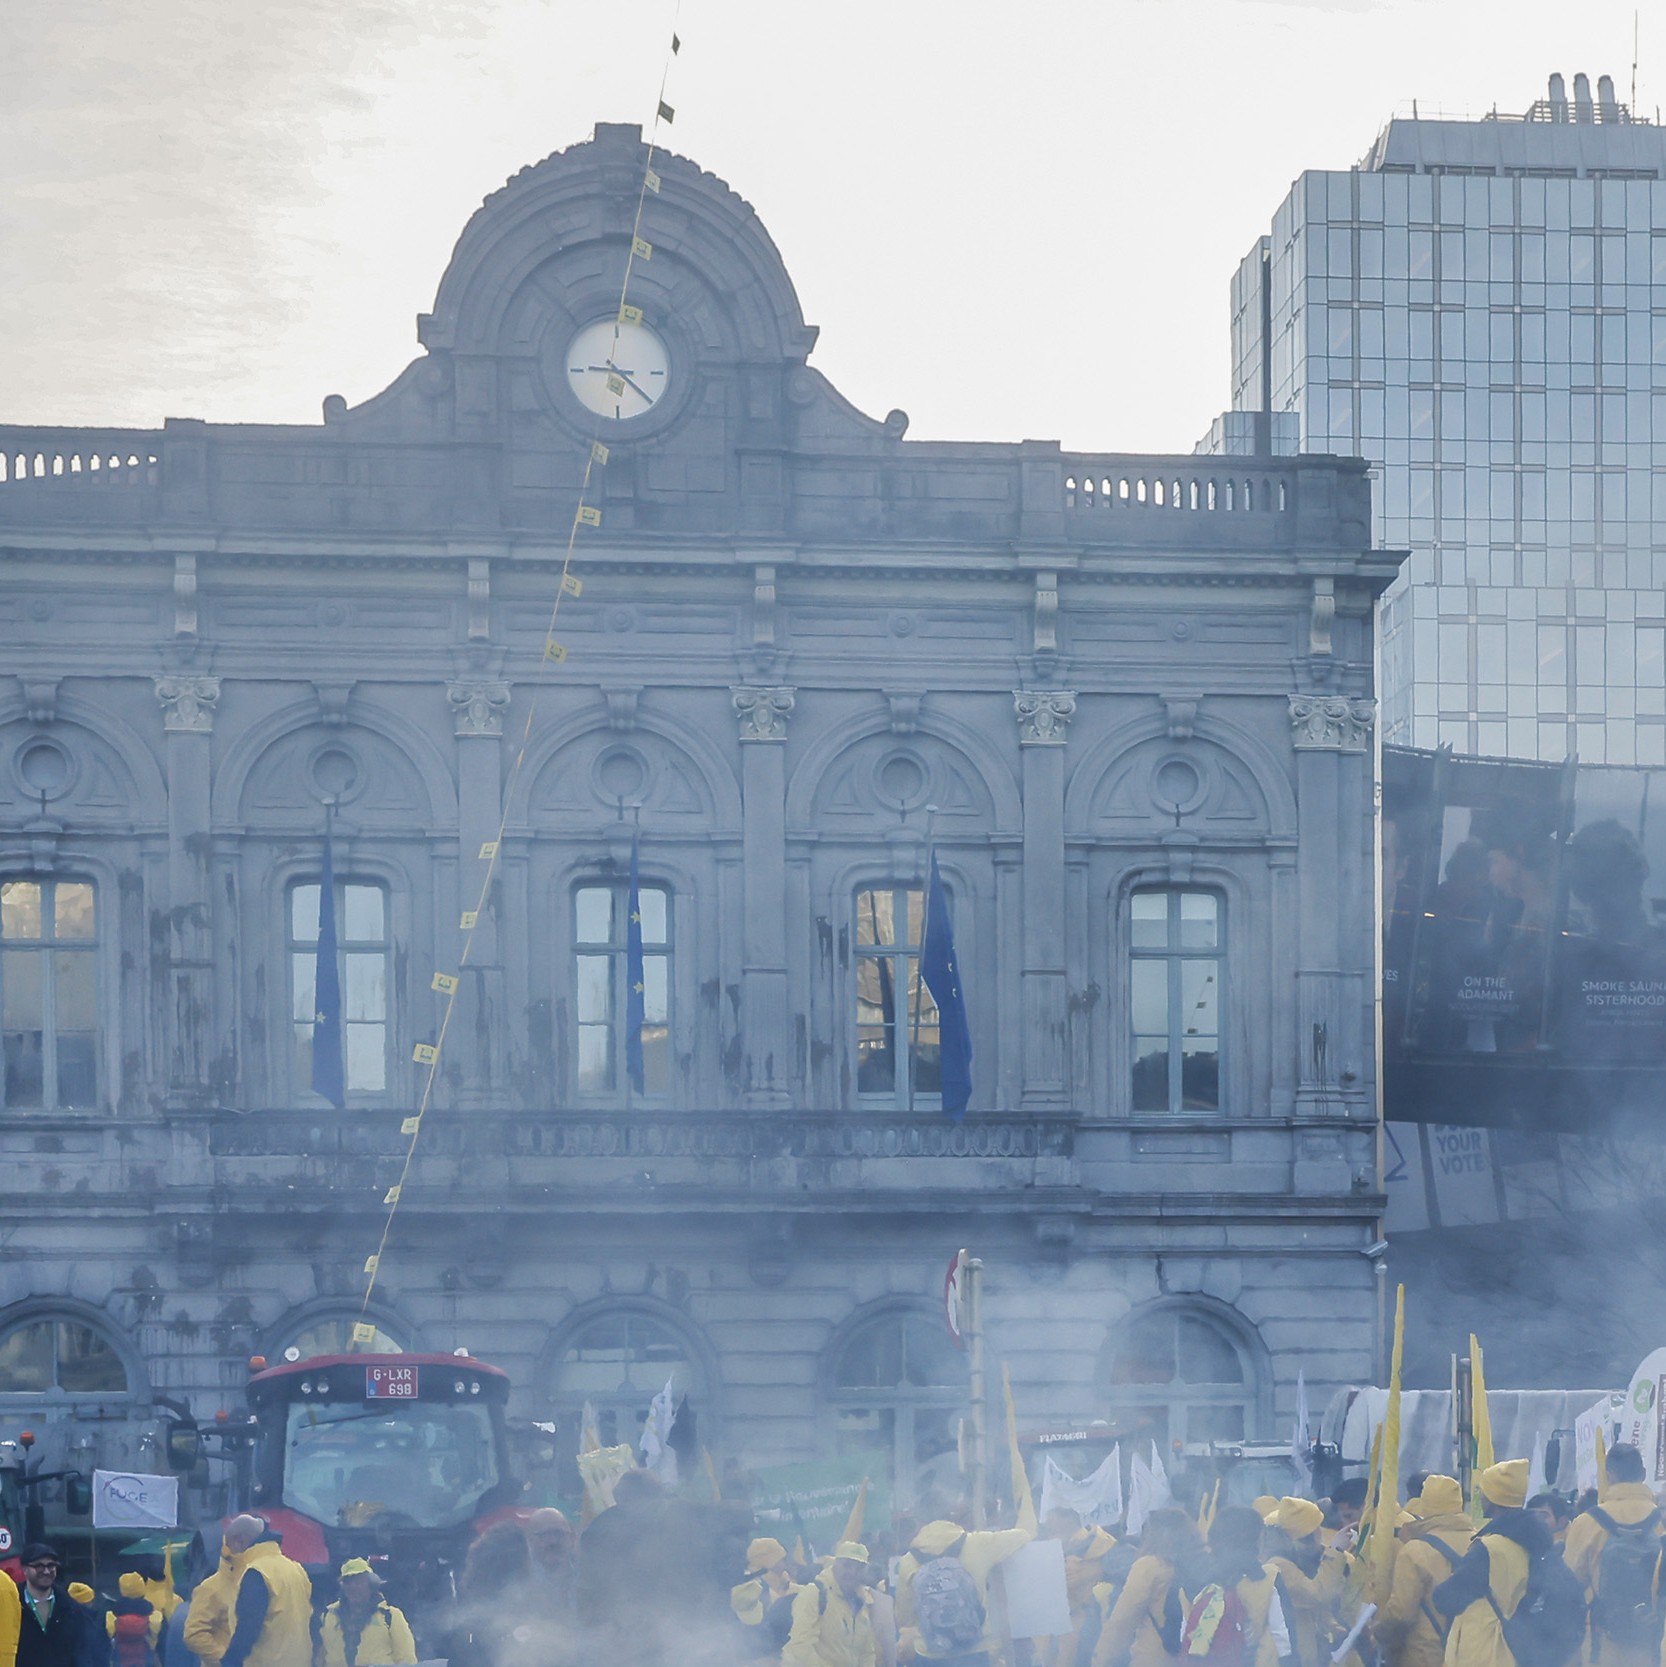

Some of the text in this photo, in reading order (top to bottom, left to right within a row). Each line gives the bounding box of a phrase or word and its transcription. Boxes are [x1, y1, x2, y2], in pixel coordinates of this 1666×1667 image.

[1464, 976, 1506, 988] ON THE
[1582, 981, 1626, 992] SMOKE
[1457, 989, 1514, 1001] ADAMANT
[1586, 994, 1665, 1006] SISTERHOOD
[1436, 1130, 1482, 1154] YOUR
[1439, 1152, 1485, 1175] VOTE
[389, 1383, 411, 1395] 698
